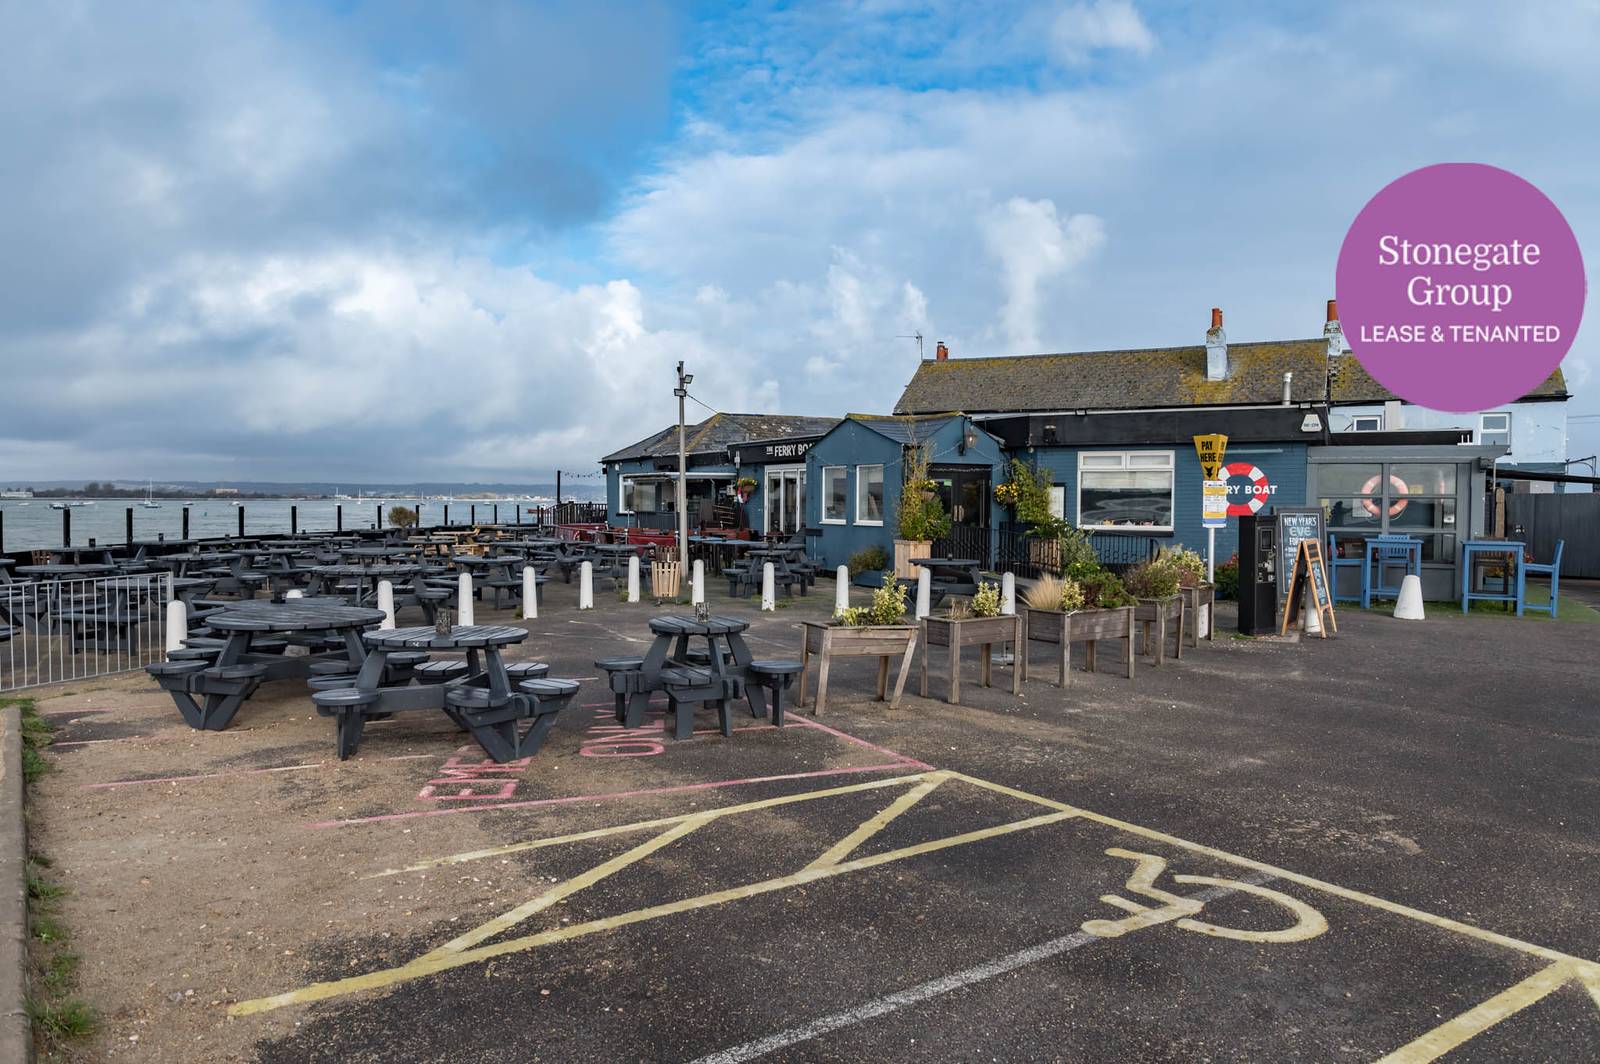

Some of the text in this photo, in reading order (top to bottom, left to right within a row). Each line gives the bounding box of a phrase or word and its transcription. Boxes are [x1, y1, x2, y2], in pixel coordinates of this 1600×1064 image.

[774, 444, 797, 457] FERRY
[1201, 441, 1213, 451] PAY
[1200, 453, 1217, 462] HERE
[1244, 485, 1278, 494] BOAT
[1284, 517, 1298, 526] NEW
